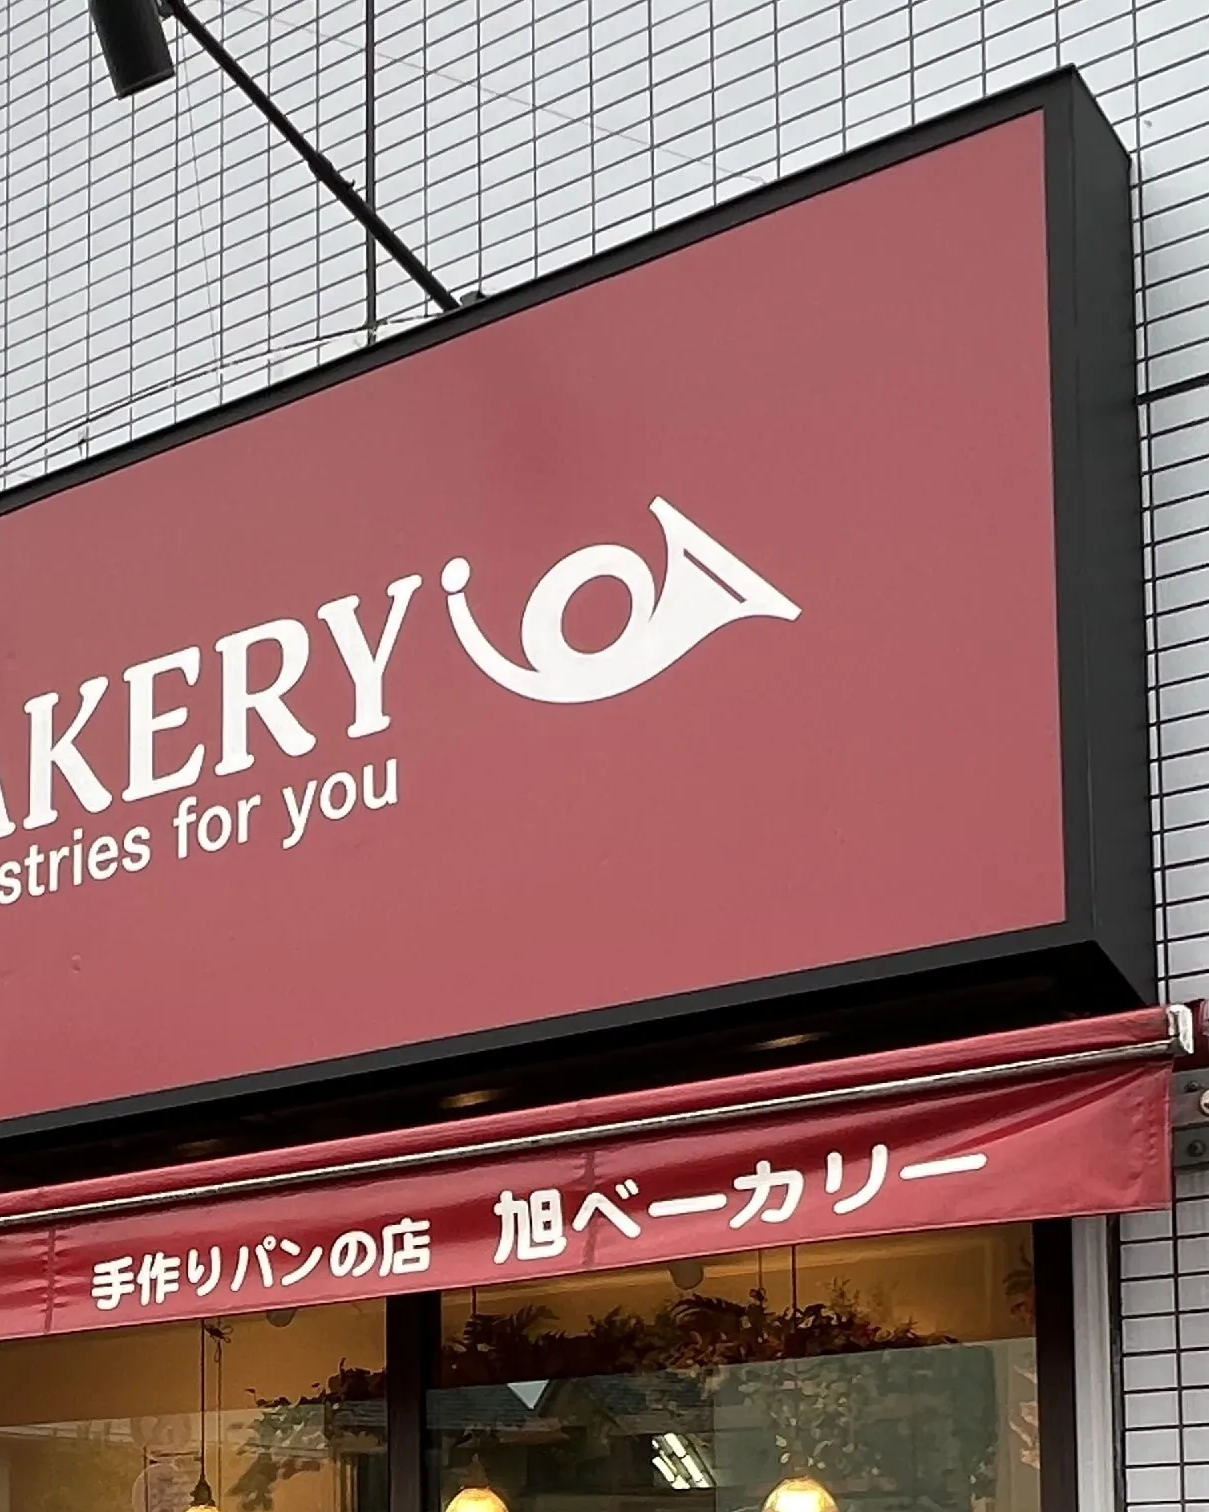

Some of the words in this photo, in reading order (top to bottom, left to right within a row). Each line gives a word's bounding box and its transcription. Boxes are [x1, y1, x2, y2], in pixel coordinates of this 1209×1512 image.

[174, 794, 261, 859] for
[282, 758, 398, 849] you
[91, 1218, 430, 1310] 手作りパンの店
[493, 1144, 988, 1264] 旭ベーカリー
